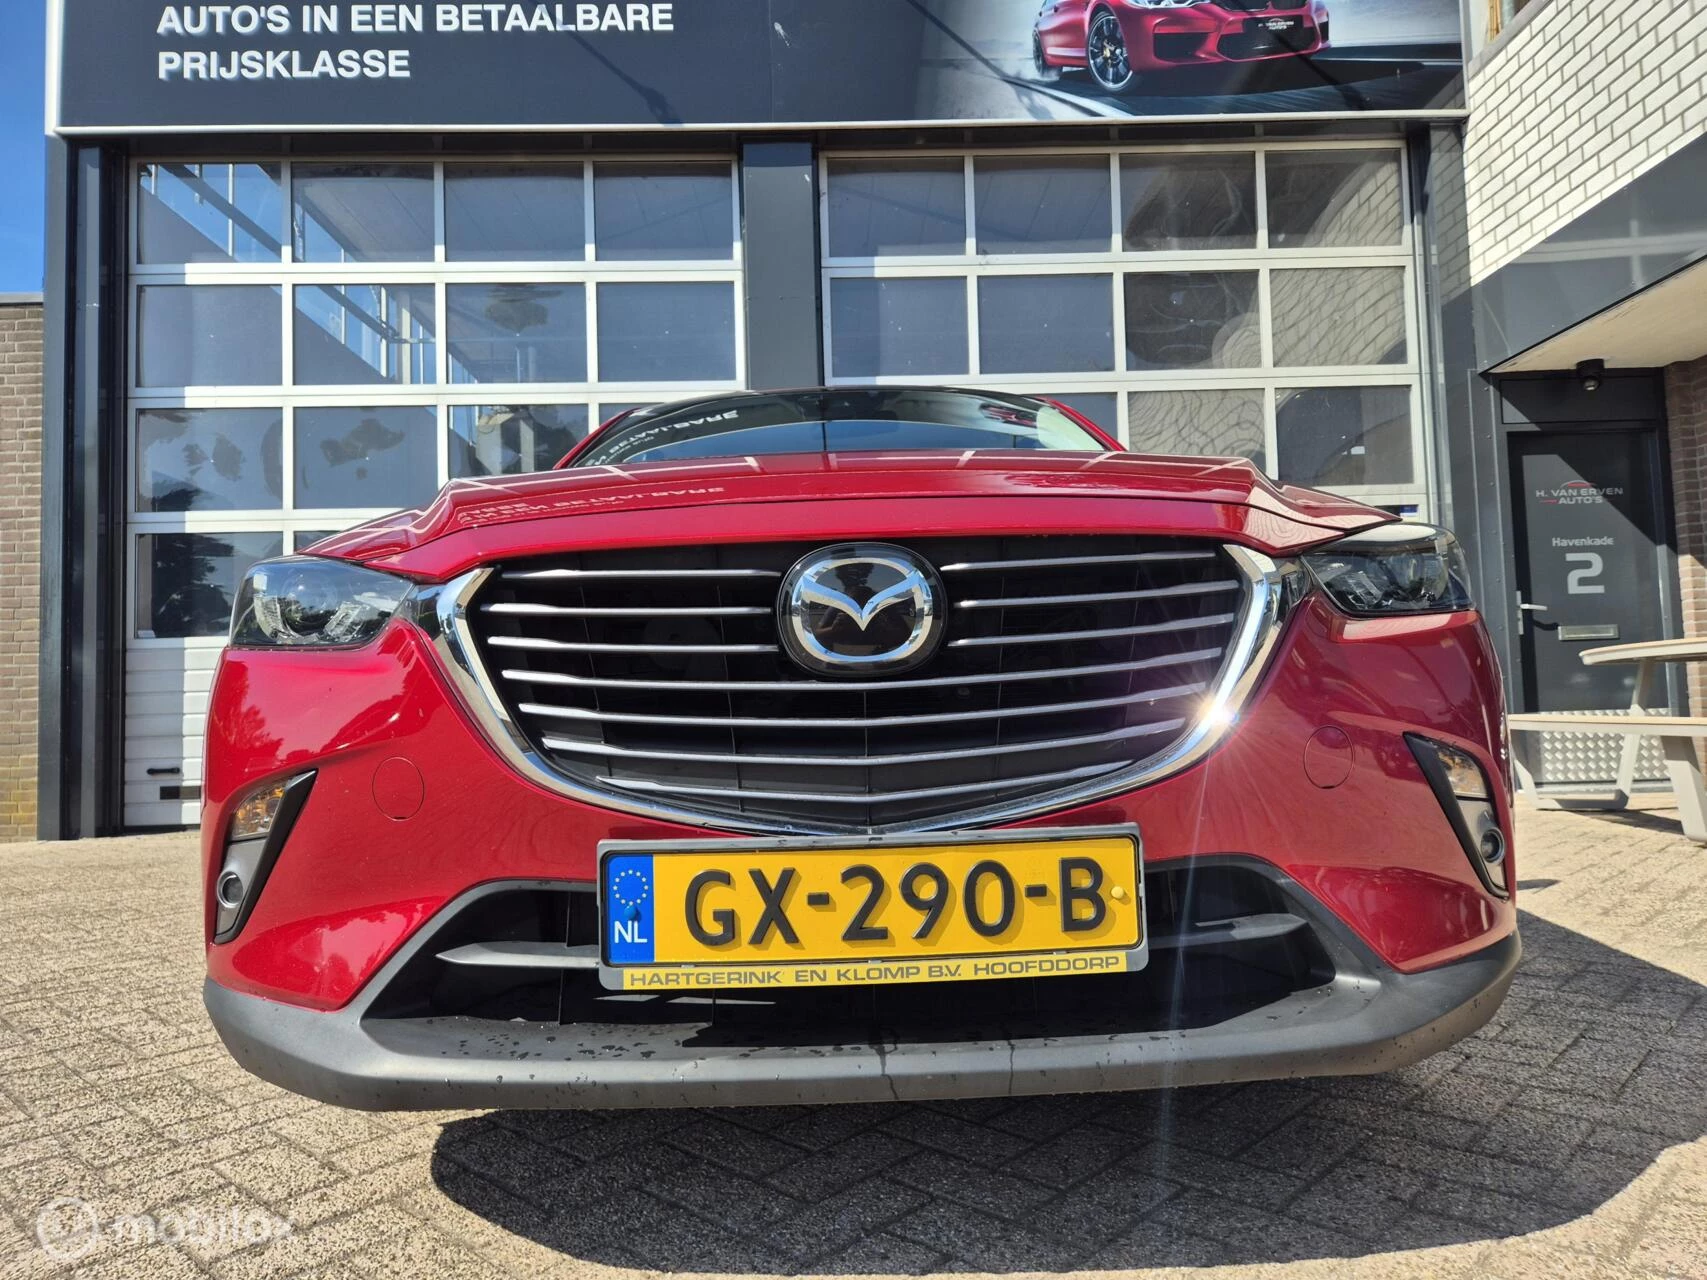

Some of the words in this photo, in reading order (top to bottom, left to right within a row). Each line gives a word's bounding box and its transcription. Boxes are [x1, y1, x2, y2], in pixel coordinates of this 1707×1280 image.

[157, 5, 290, 33] AUTO'S
[302, 5, 338, 32] IN
[351, 4, 423, 32] EEN
[436, 3, 674, 31] BETAALBARE
[158, 50, 411, 79] PRIJSKLASSE
[1535, 489, 1548, 497] H.
[1551, 488, 1577, 497] VAN
[1580, 487, 1623, 496] ERVEN
[1558, 496, 1603, 504] AUTO'S
[1552, 536, 1614, 547] Havenkade
[1565, 552, 1605, 594] 2
[684, 857, 1106, 947] GX-290-B
[614, 920, 648, 944] NL
[630, 970, 783, 987] HARTGERINK
[795, 968, 827, 983] EN
[837, 966, 921, 983] KLOMP
[974, 956, 1119, 977] HOOFDDORP
